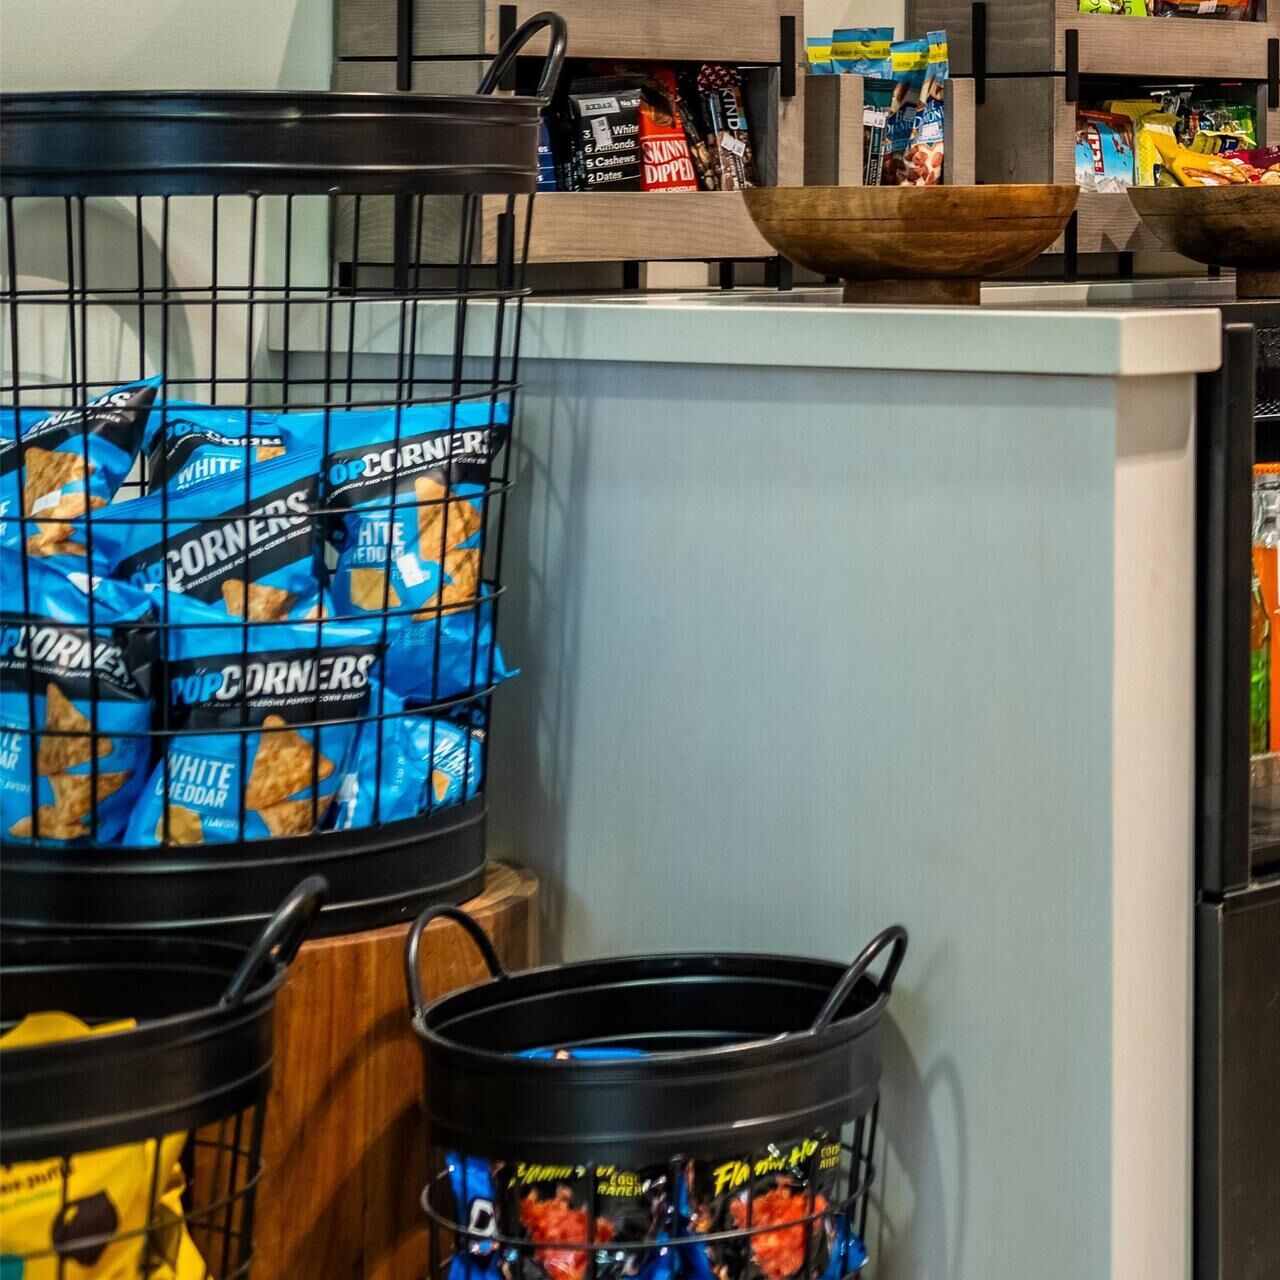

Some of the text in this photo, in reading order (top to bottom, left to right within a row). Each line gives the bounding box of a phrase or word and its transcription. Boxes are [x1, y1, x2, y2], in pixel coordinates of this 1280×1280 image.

[722, 88, 739, 131] KIND
[583, 125, 639, 139] 3 White
[584, 139, 636, 154] 6 Almonds
[586, 154, 636, 168] 5 Cashews
[645, 159, 695, 184] DIPPED
[587, 169, 623, 183] 2 Dates
[177, 456, 242, 484] WHITE
[171, 653, 376, 706] POPCORNERS
[167, 751, 235, 790] WHITE
